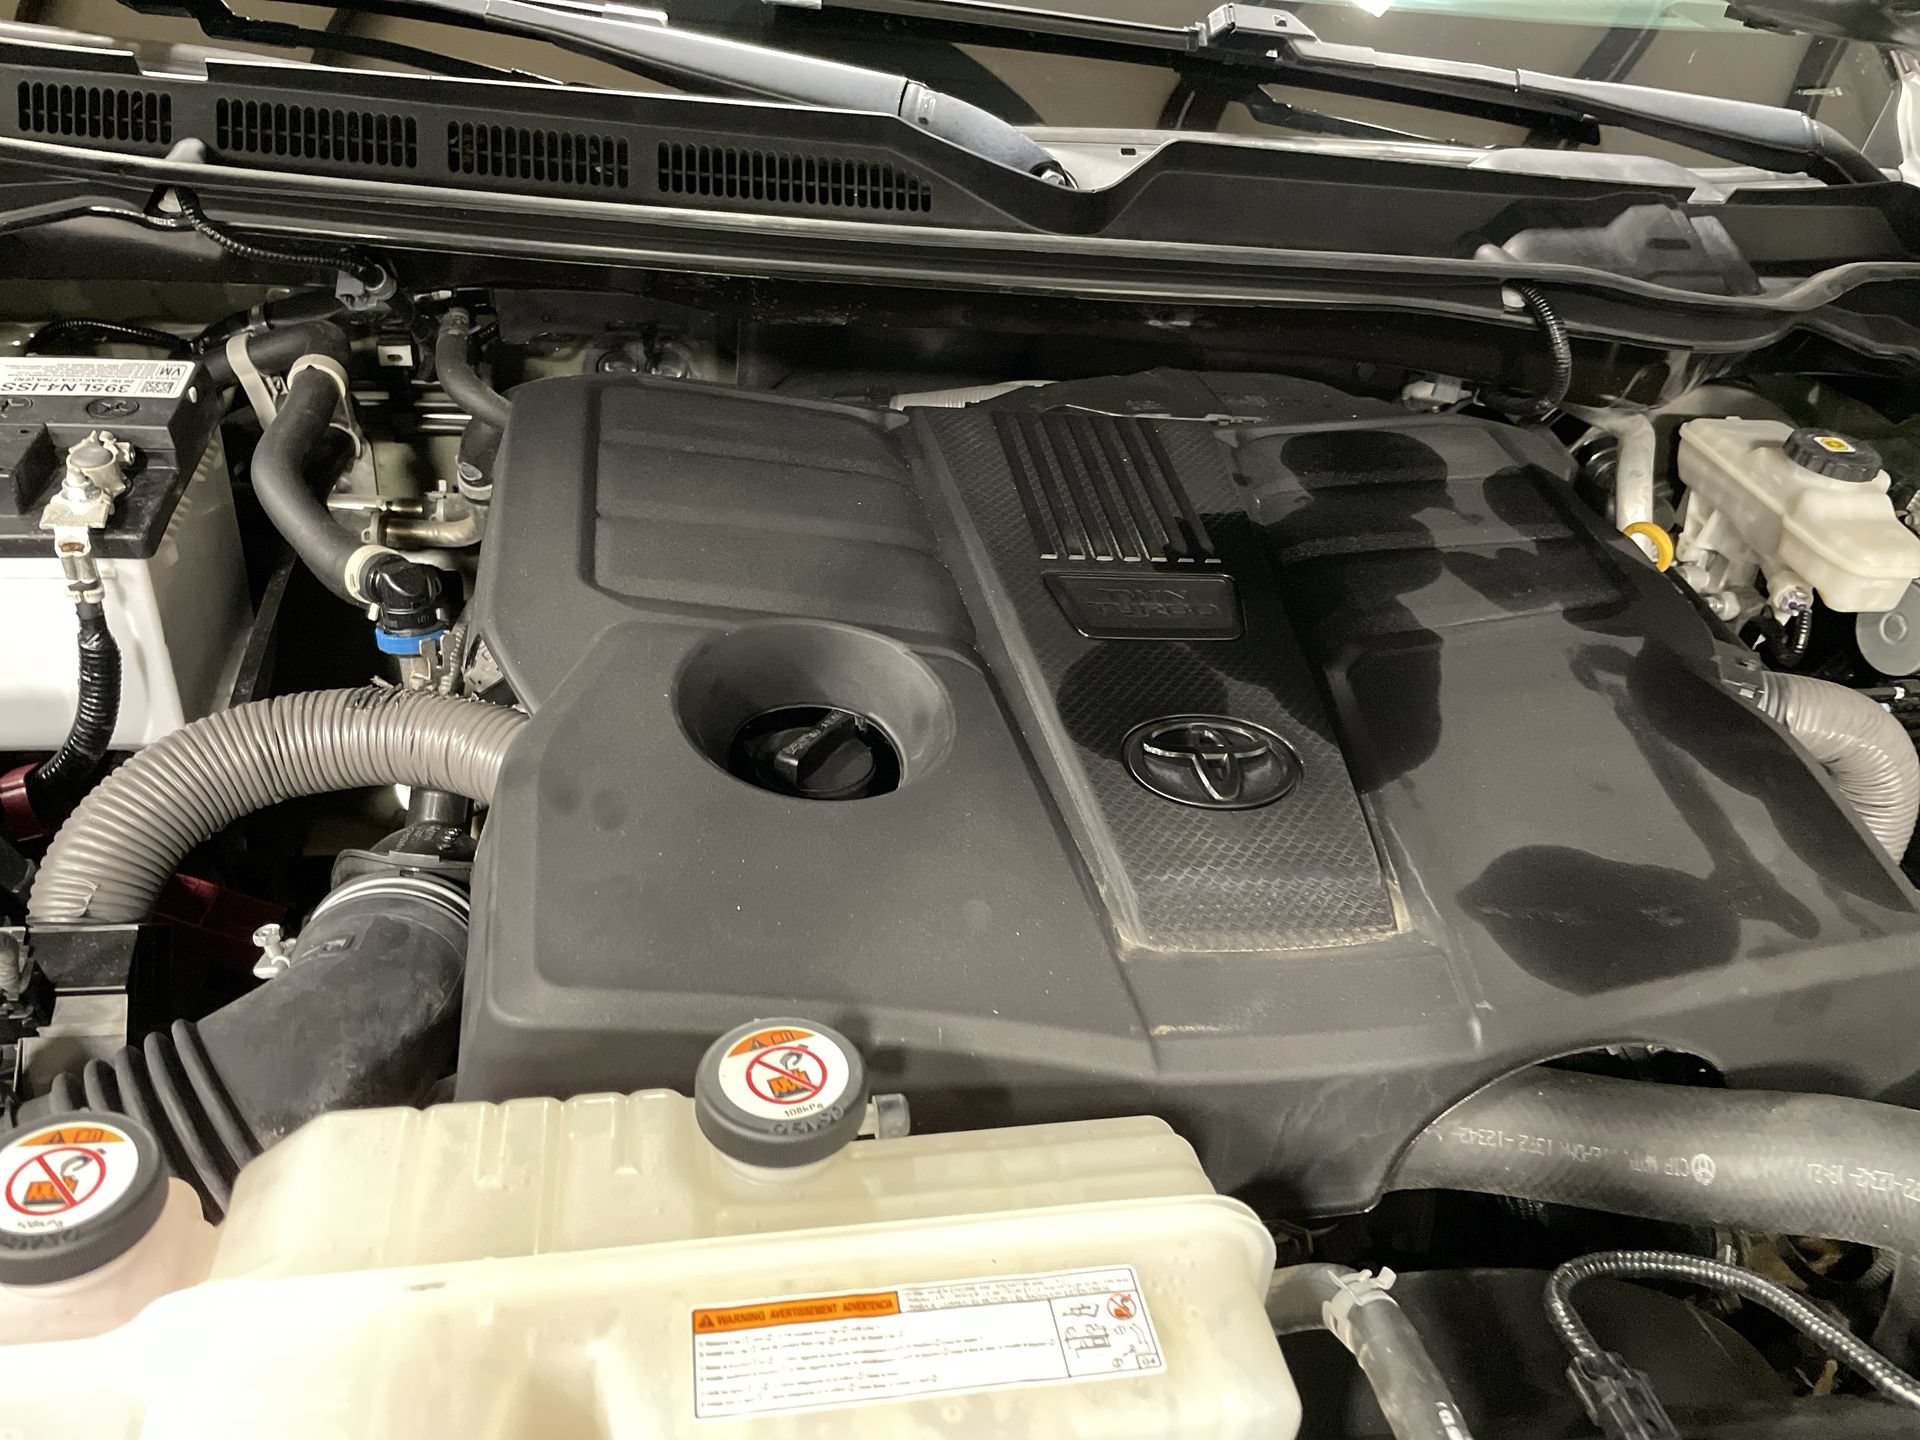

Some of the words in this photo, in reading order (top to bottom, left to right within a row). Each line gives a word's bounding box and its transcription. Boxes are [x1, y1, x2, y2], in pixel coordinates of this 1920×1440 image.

[160, 367, 181, 376] VM
[1, 382, 131, 393] 395LN4-ISS
[784, 1103, 824, 1118] 108kPa
[716, 1310, 766, 1325] WARNING
[769, 1303, 838, 1320] AVERTISSEMENT
[843, 1299, 894, 1312] ADVERTENCIA
